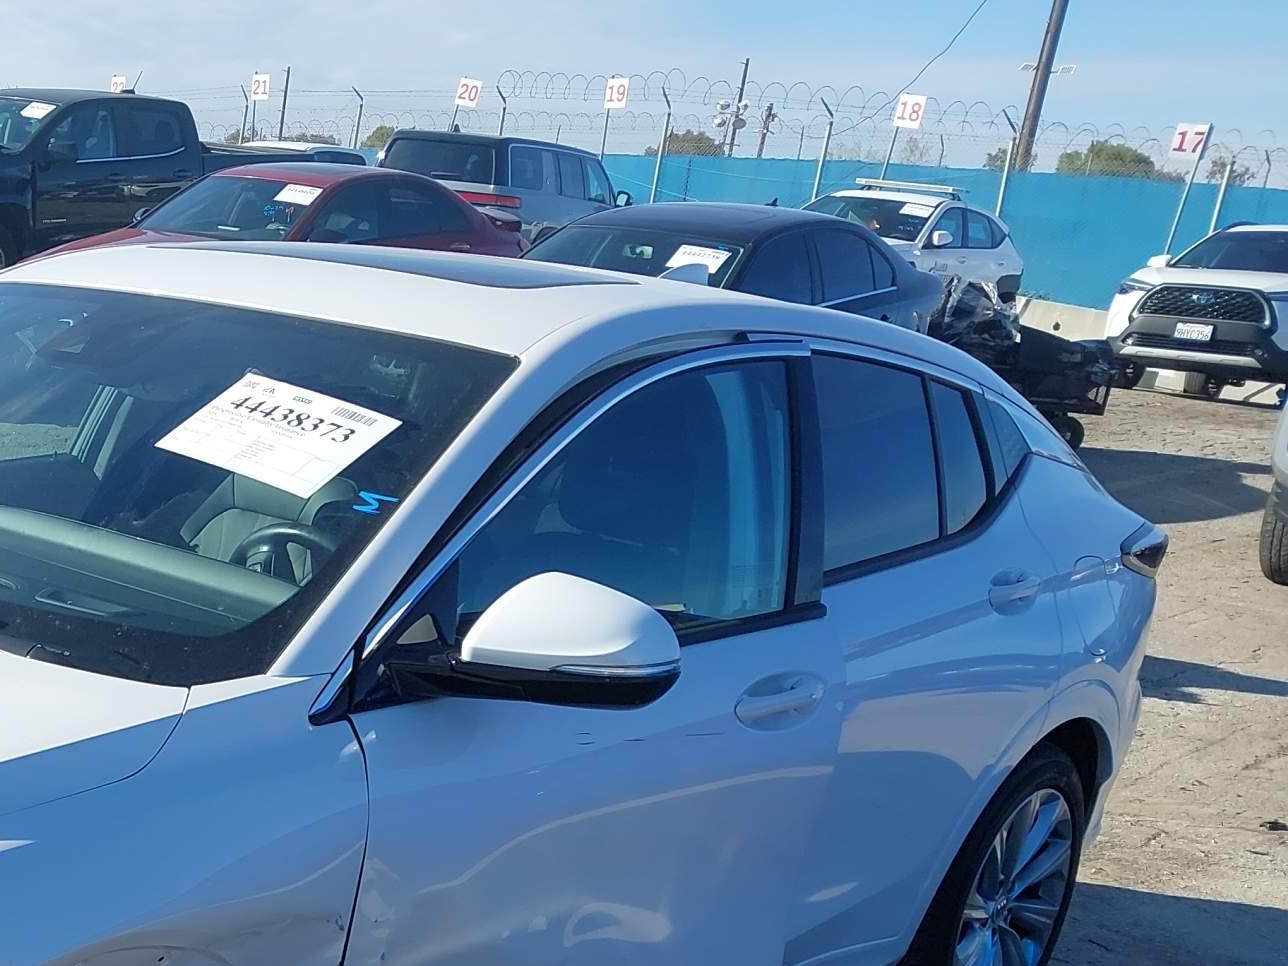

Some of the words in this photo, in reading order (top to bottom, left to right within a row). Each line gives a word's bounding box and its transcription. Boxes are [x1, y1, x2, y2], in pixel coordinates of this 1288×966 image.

[253, 79, 267, 95] 21
[457, 83, 479, 103] 20
[607, 84, 626, 103] 19
[896, 101, 922, 122] 18
[1172, 130, 1206, 154] 17
[229, 395, 357, 444] 44438373
